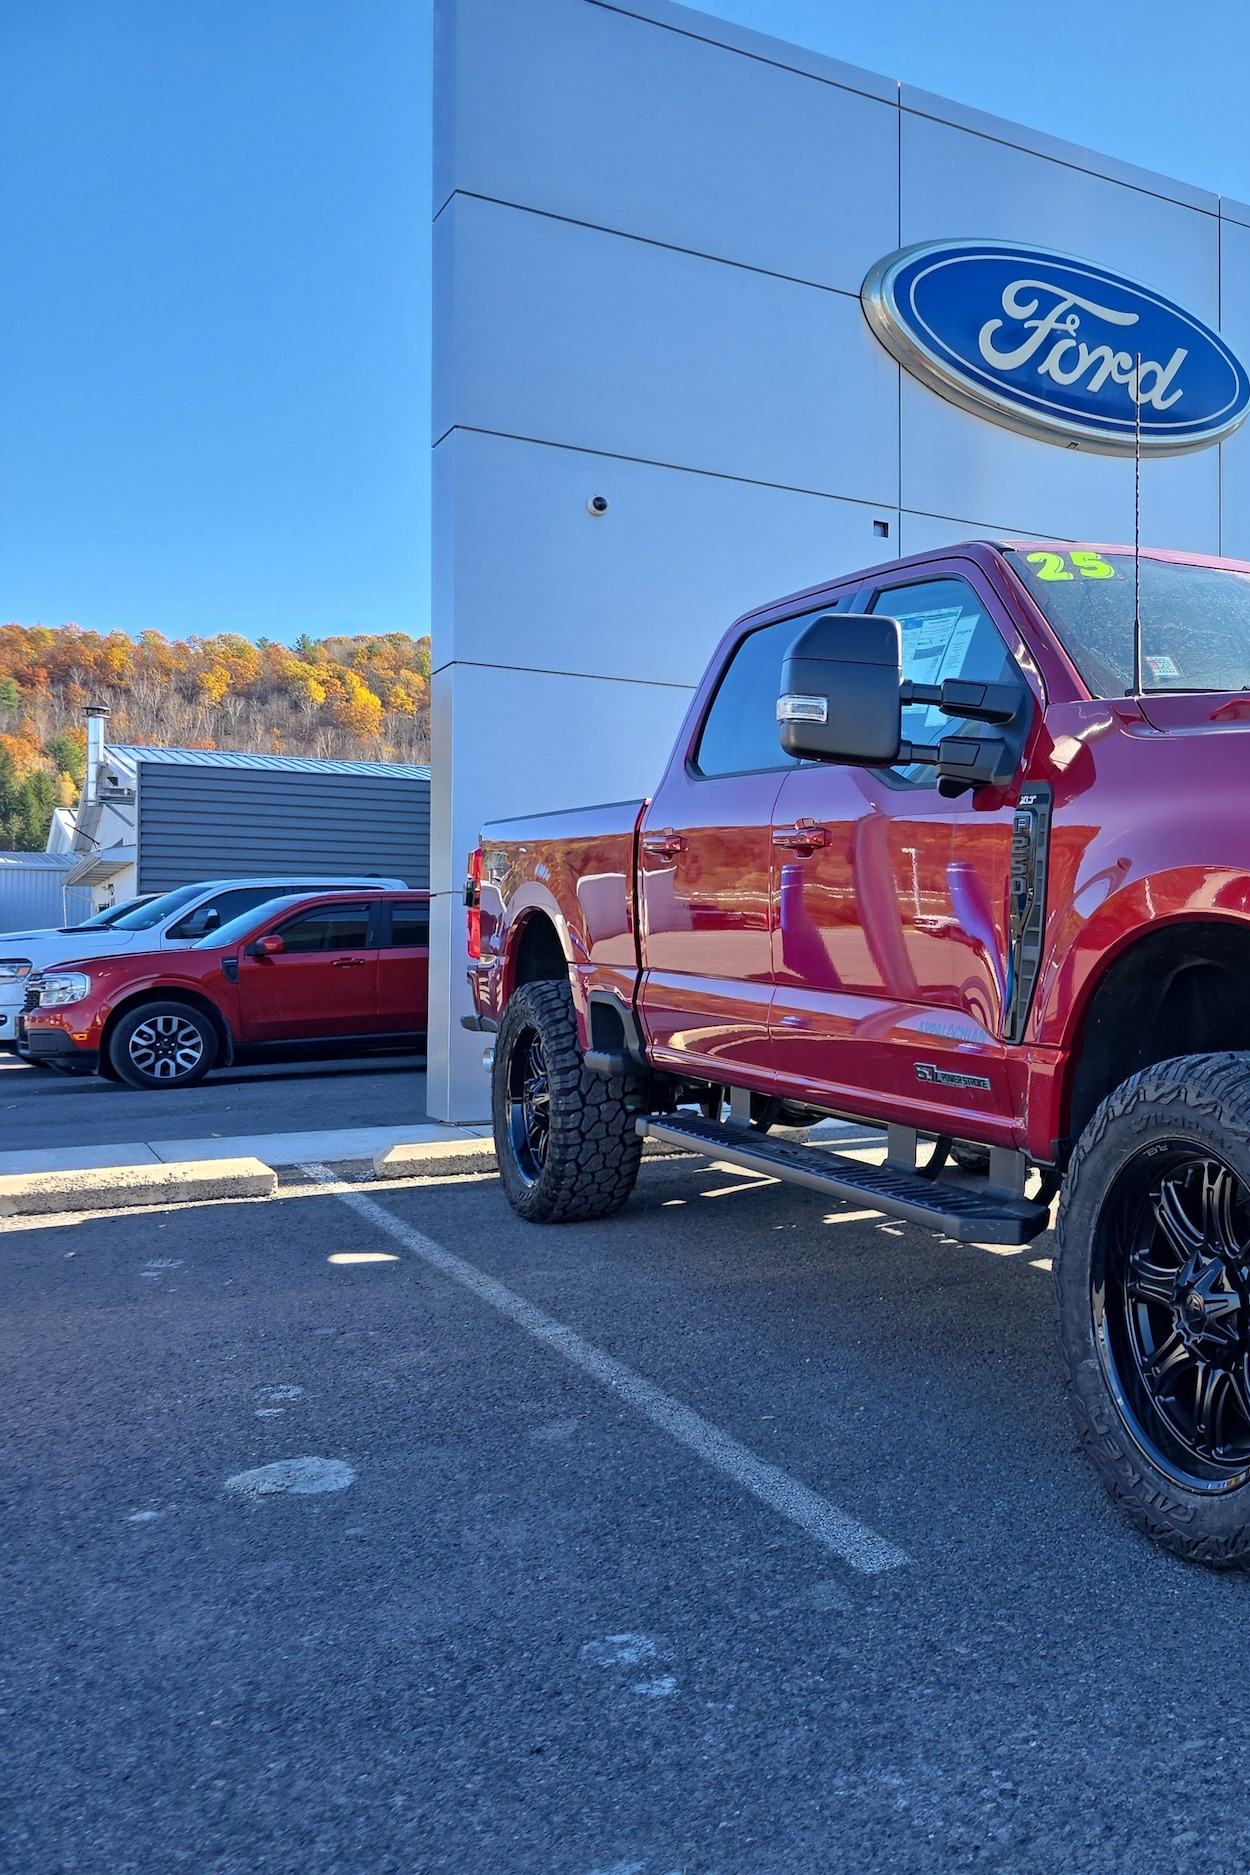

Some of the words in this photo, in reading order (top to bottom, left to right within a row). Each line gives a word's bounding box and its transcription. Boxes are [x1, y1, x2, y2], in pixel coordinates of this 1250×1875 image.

[978, 280, 1189, 411] Ford
[1027, 552, 1115, 581] 25
[1019, 795, 1036, 805] XLT
